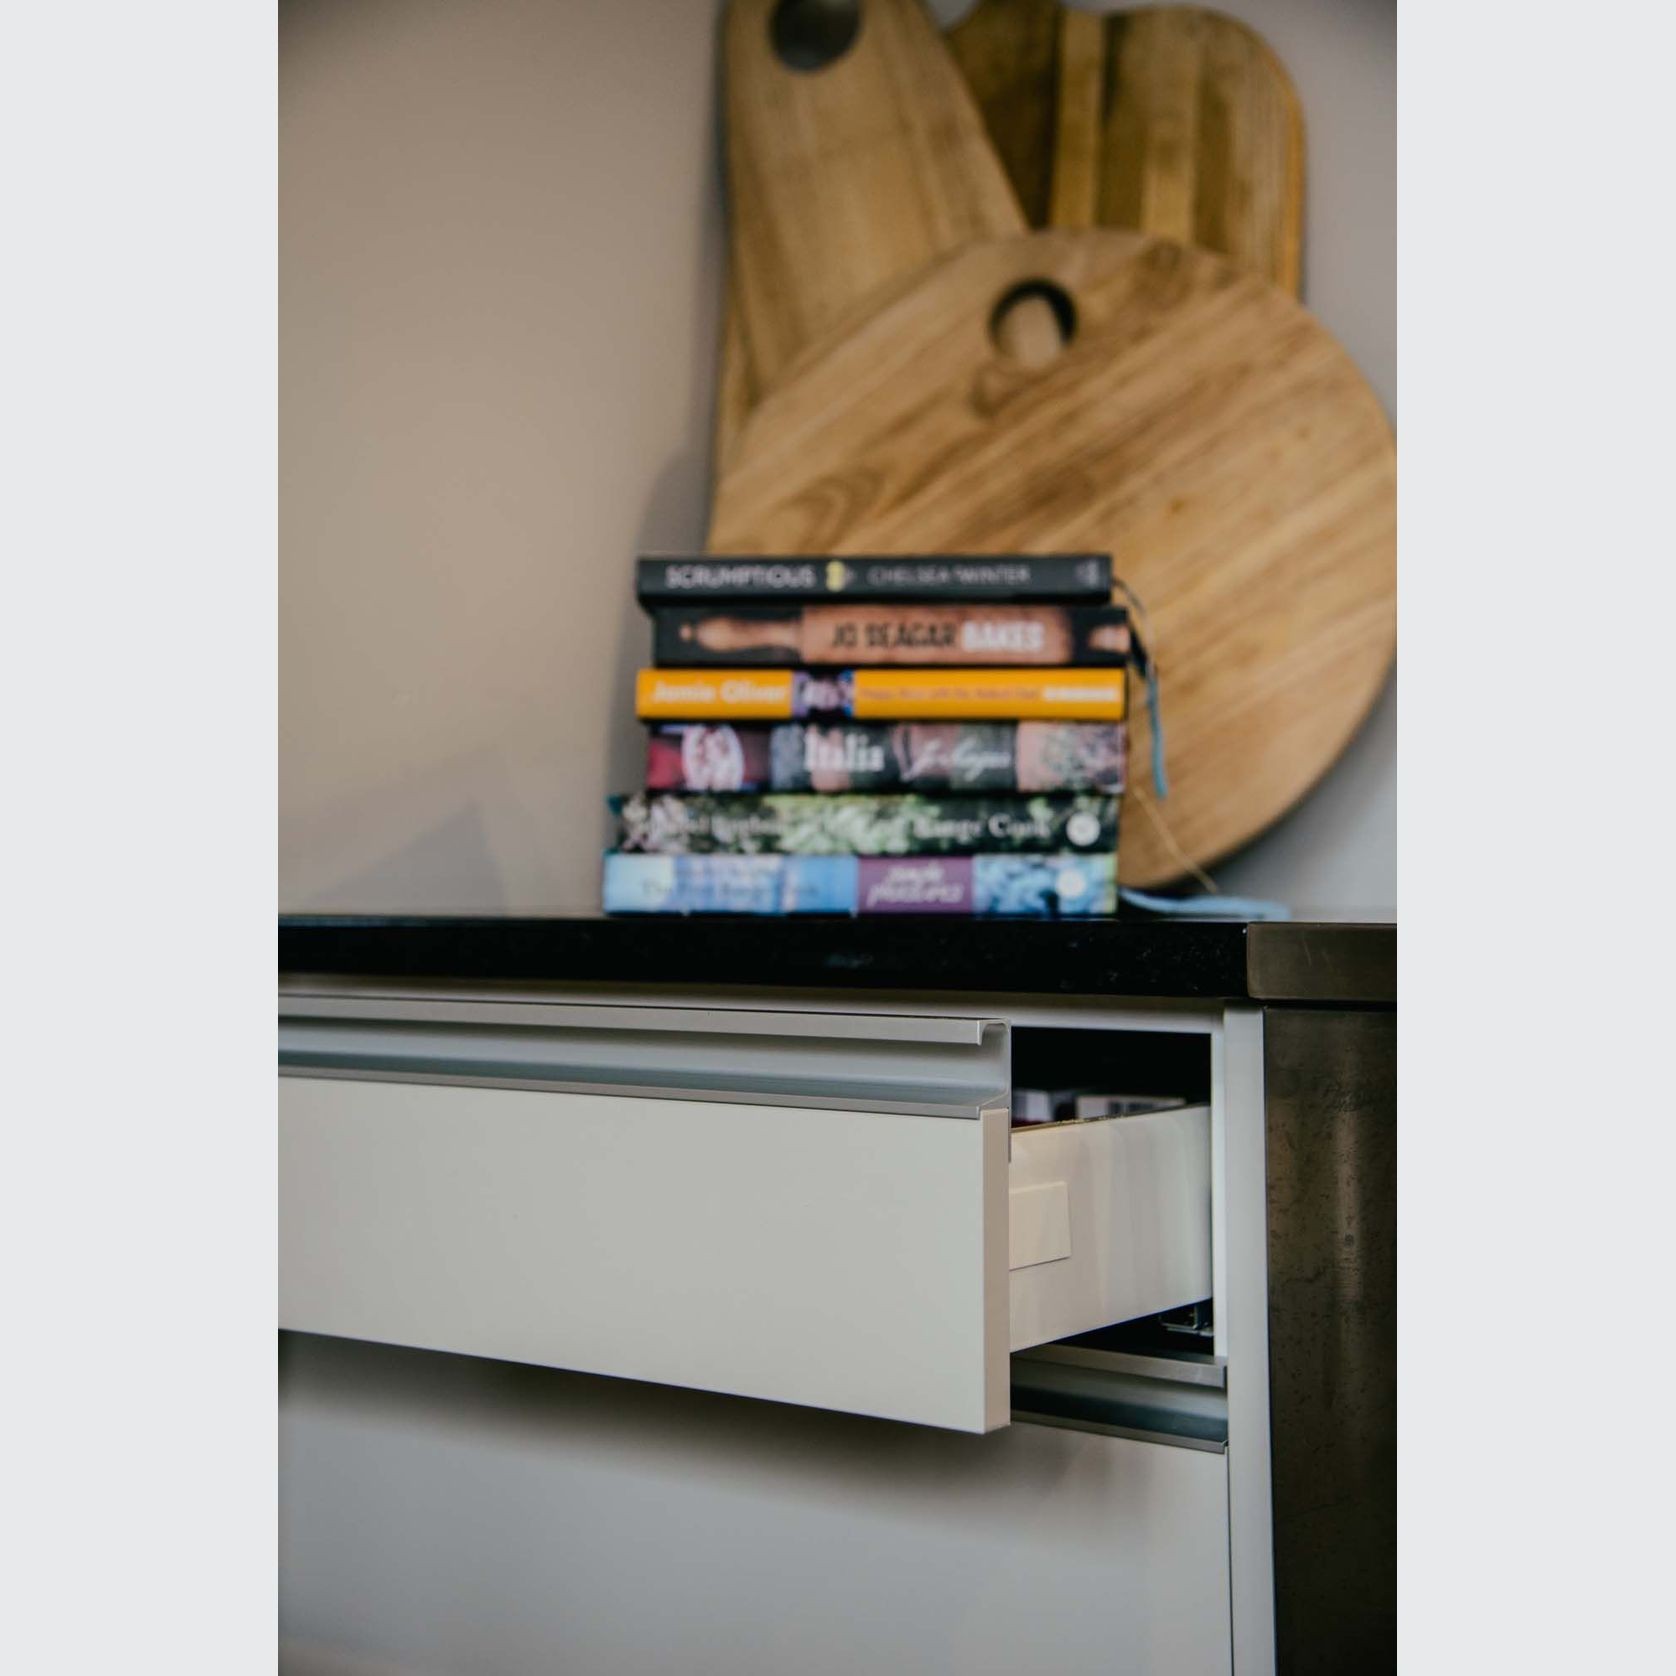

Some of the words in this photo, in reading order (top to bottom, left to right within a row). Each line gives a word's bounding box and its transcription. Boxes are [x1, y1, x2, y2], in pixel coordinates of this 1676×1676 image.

[665, 563, 816, 589] SCRUMPTIOUS
[866, 564, 951, 587] CHELSEA
[832, 621, 858, 647] JO
[864, 621, 957, 648] SEAGAR
[960, 618, 1045, 653] BAKES
[653, 680, 715, 704] Jamie
[720, 679, 788, 705] Oliver
[804, 732, 886, 772] Italia
